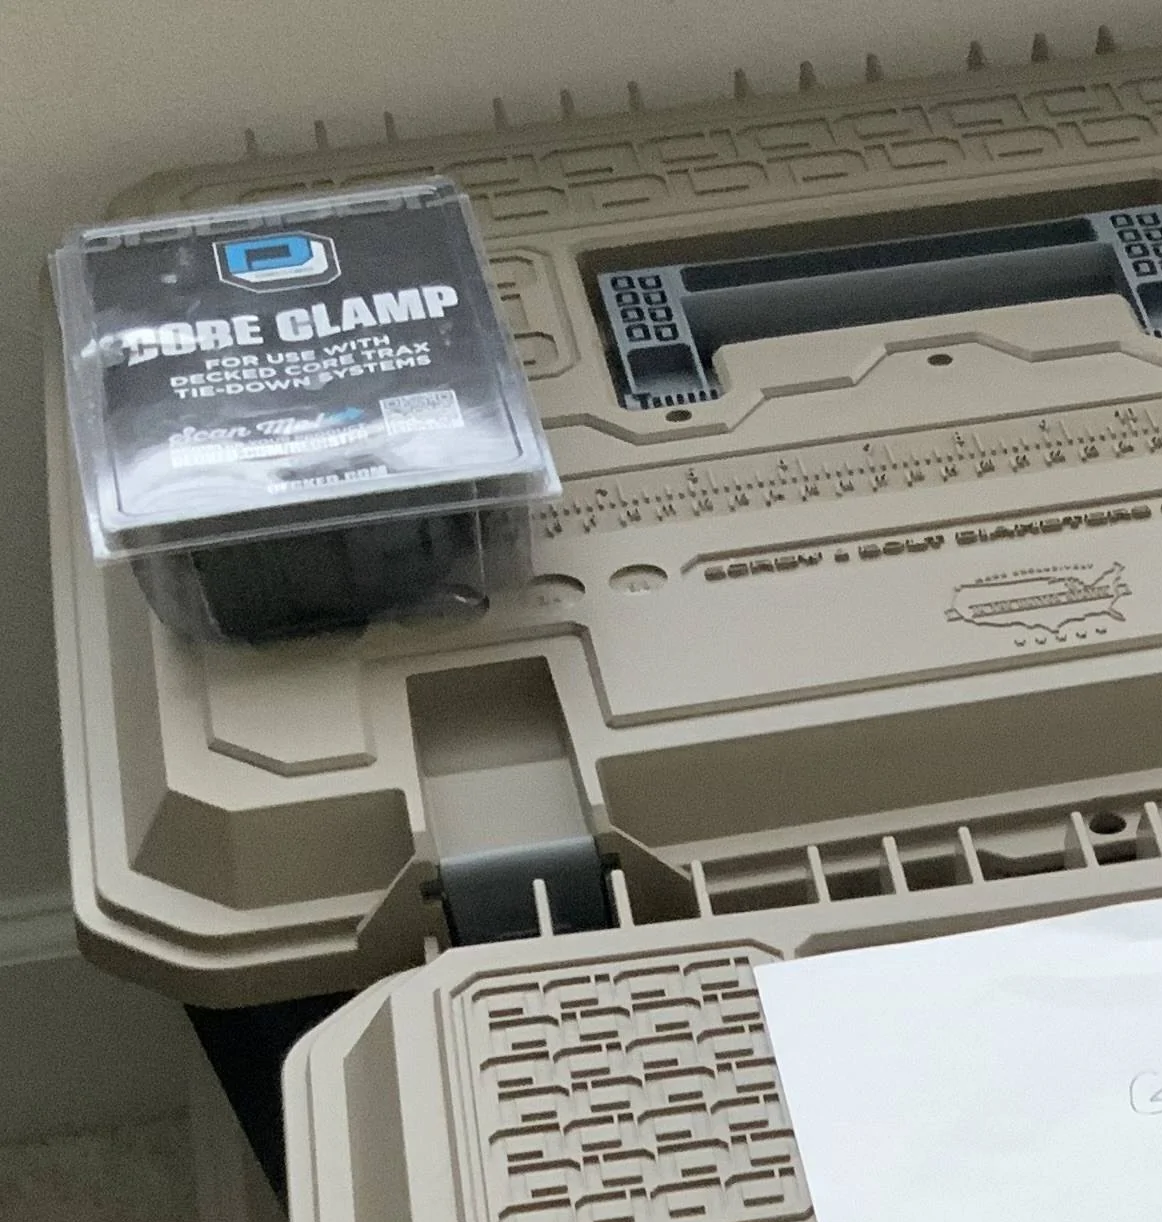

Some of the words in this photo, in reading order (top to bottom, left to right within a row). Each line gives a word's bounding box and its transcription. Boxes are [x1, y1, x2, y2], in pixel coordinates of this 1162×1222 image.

[122, 314, 264, 367] CORE
[274, 285, 459, 342] CLAMP
[169, 366, 277, 388] DECKED
[284, 352, 355, 376] CORE
[357, 340, 431, 362] TRAX
[204, 354, 259, 371] FOR
[266, 349, 316, 365] USE
[323, 333, 390, 355] WITH
[173, 375, 311, 399] TIE-DOWN
[318, 354, 432, 383] SYSTEMS
